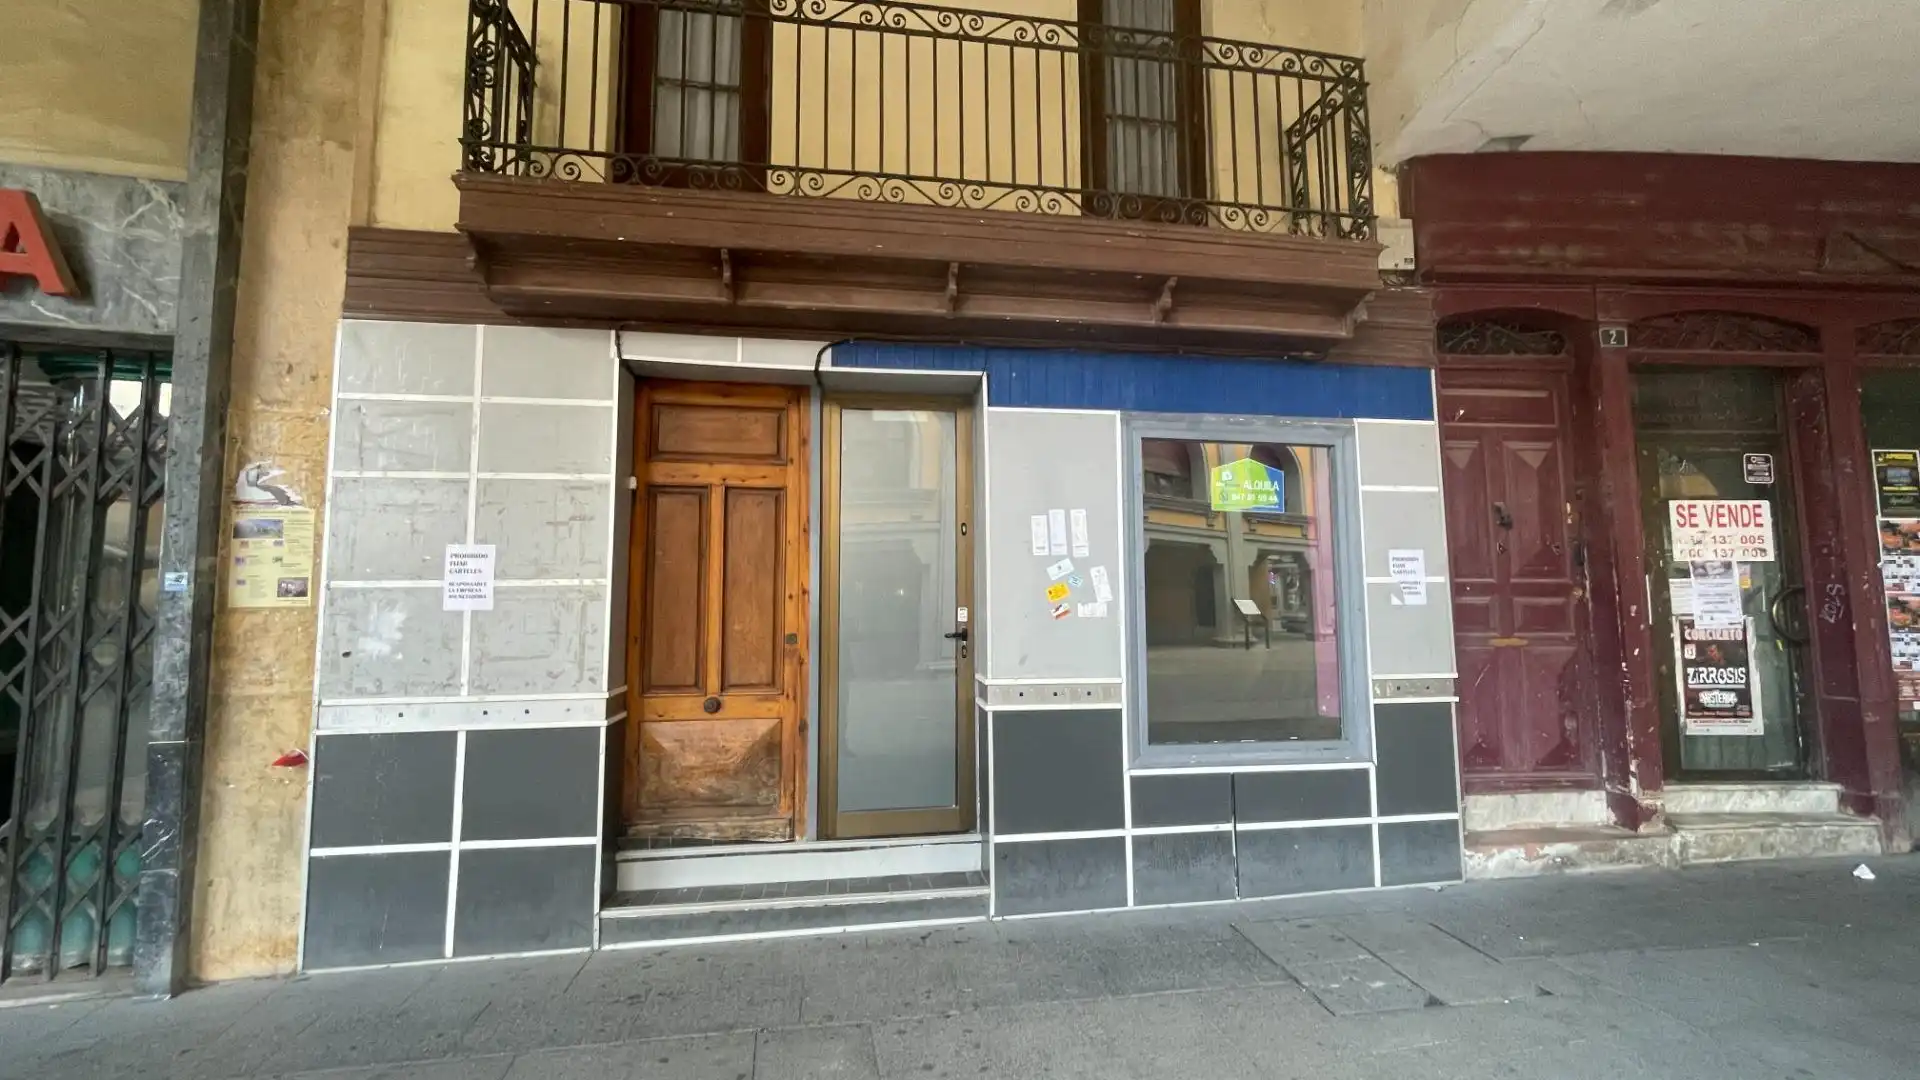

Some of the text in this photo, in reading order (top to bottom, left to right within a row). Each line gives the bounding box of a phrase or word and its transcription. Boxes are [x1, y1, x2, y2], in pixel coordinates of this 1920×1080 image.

[1609, 330, 1617, 344] 2
[1243, 480, 1280, 491] ALQUILA
[1676, 504, 1764, 528] SE VENDE
[1740, 535, 1765, 545] 005
[1713, 548, 1735, 558] 137
[1684, 628, 1743, 640] CONCIERTO
